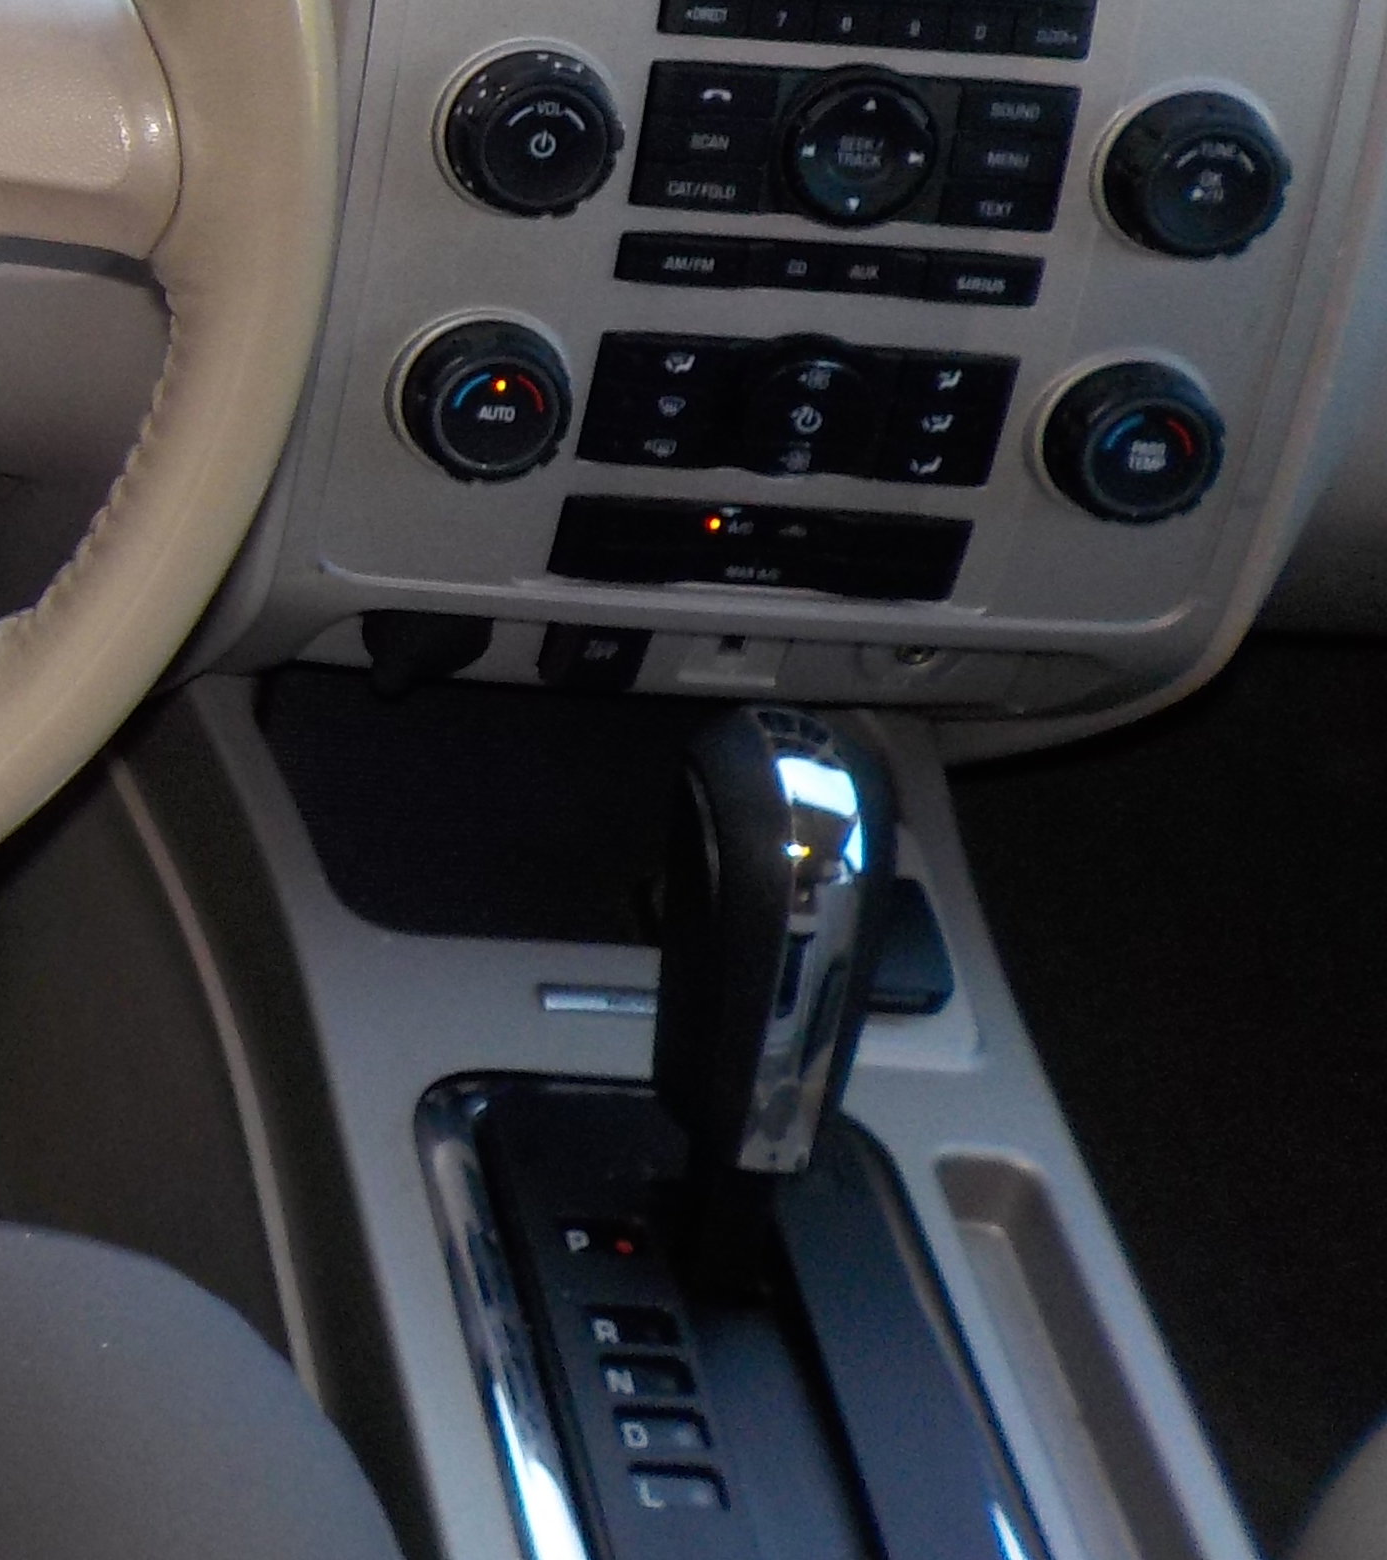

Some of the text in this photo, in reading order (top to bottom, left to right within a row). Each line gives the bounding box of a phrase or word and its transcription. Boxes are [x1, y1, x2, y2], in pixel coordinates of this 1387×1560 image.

[536, 101, 563, 118] VOL
[987, 150, 1030, 169] MENU
[661, 255, 716, 274] AM/FM
[848, 263, 879, 281] AUX
[477, 405, 516, 423] AUTO
[565, 1228, 590, 1252] P
[592, 1317, 619, 1344] R
[605, 1367, 635, 1395] N
[638, 1478, 667, 1509] L
